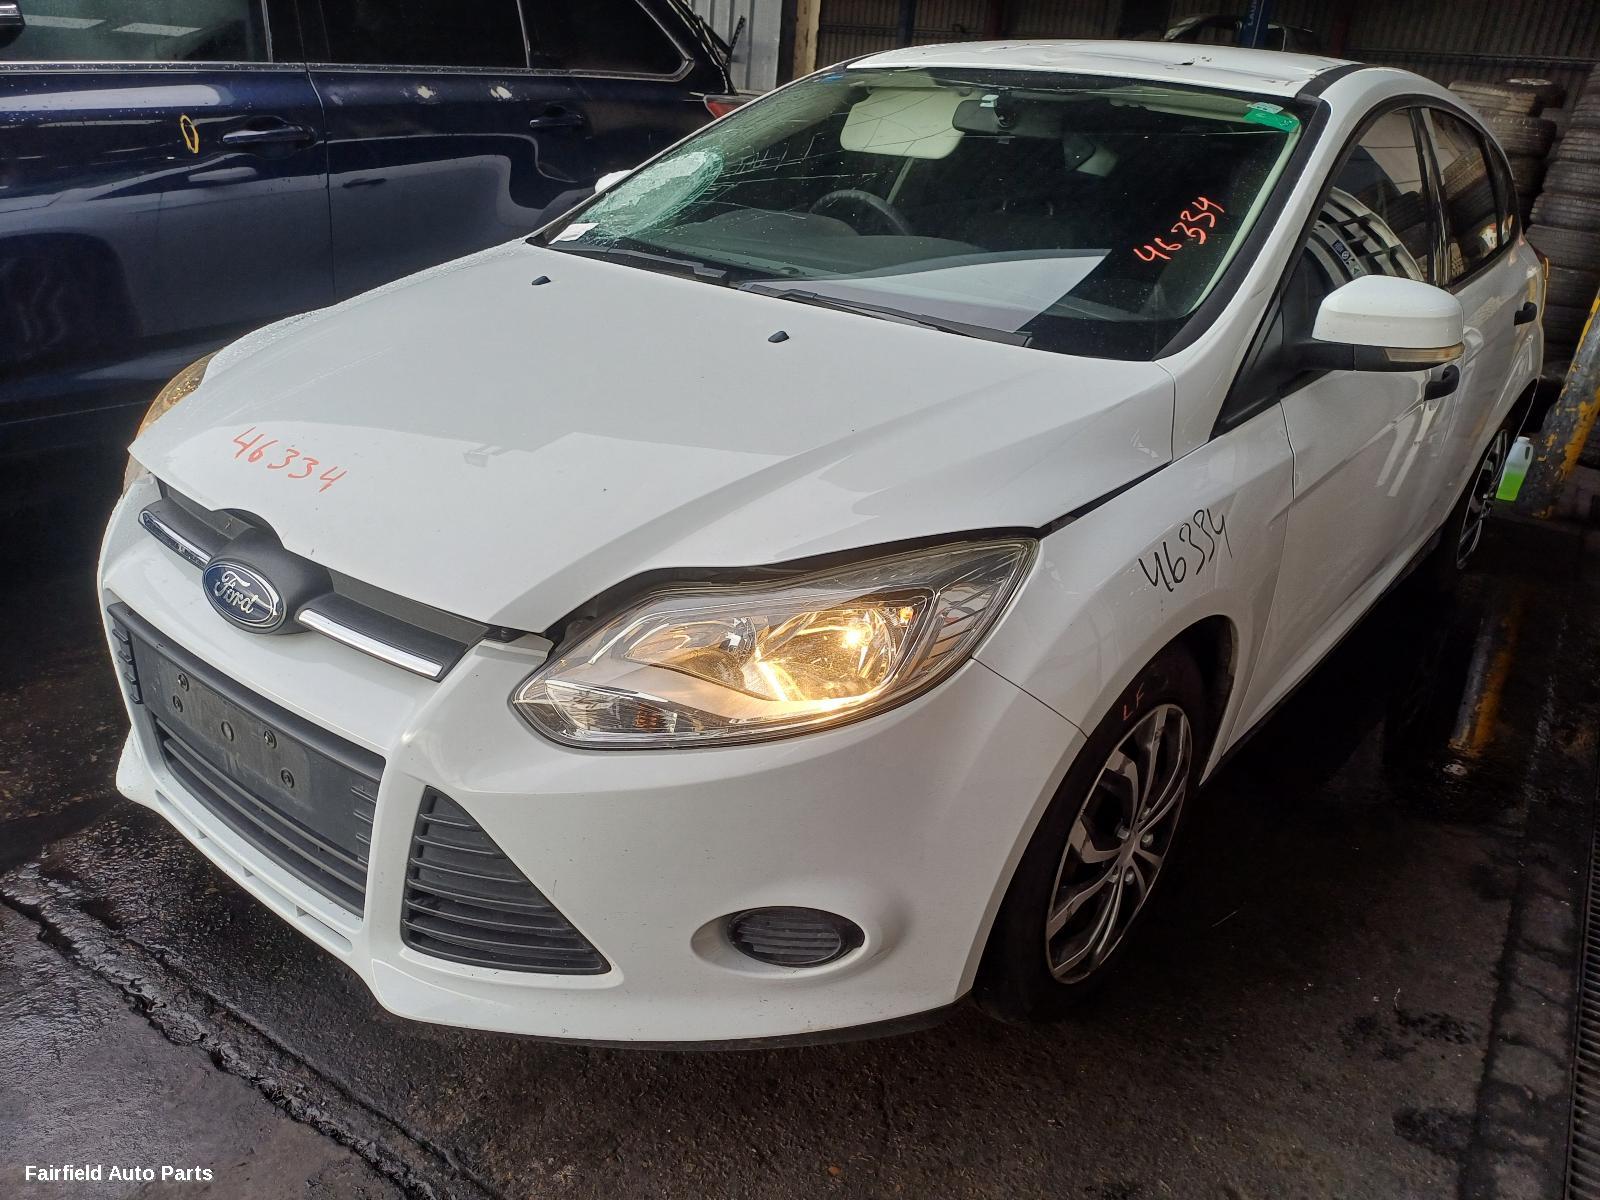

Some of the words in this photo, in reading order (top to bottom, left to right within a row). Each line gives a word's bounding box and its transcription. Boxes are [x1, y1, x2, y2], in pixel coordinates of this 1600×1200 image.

[1133, 196, 1225, 261] 46334
[232, 426, 348, 493] 46334
[1138, 508, 1232, 592] 46334
[214, 570, 259, 614] Ford
